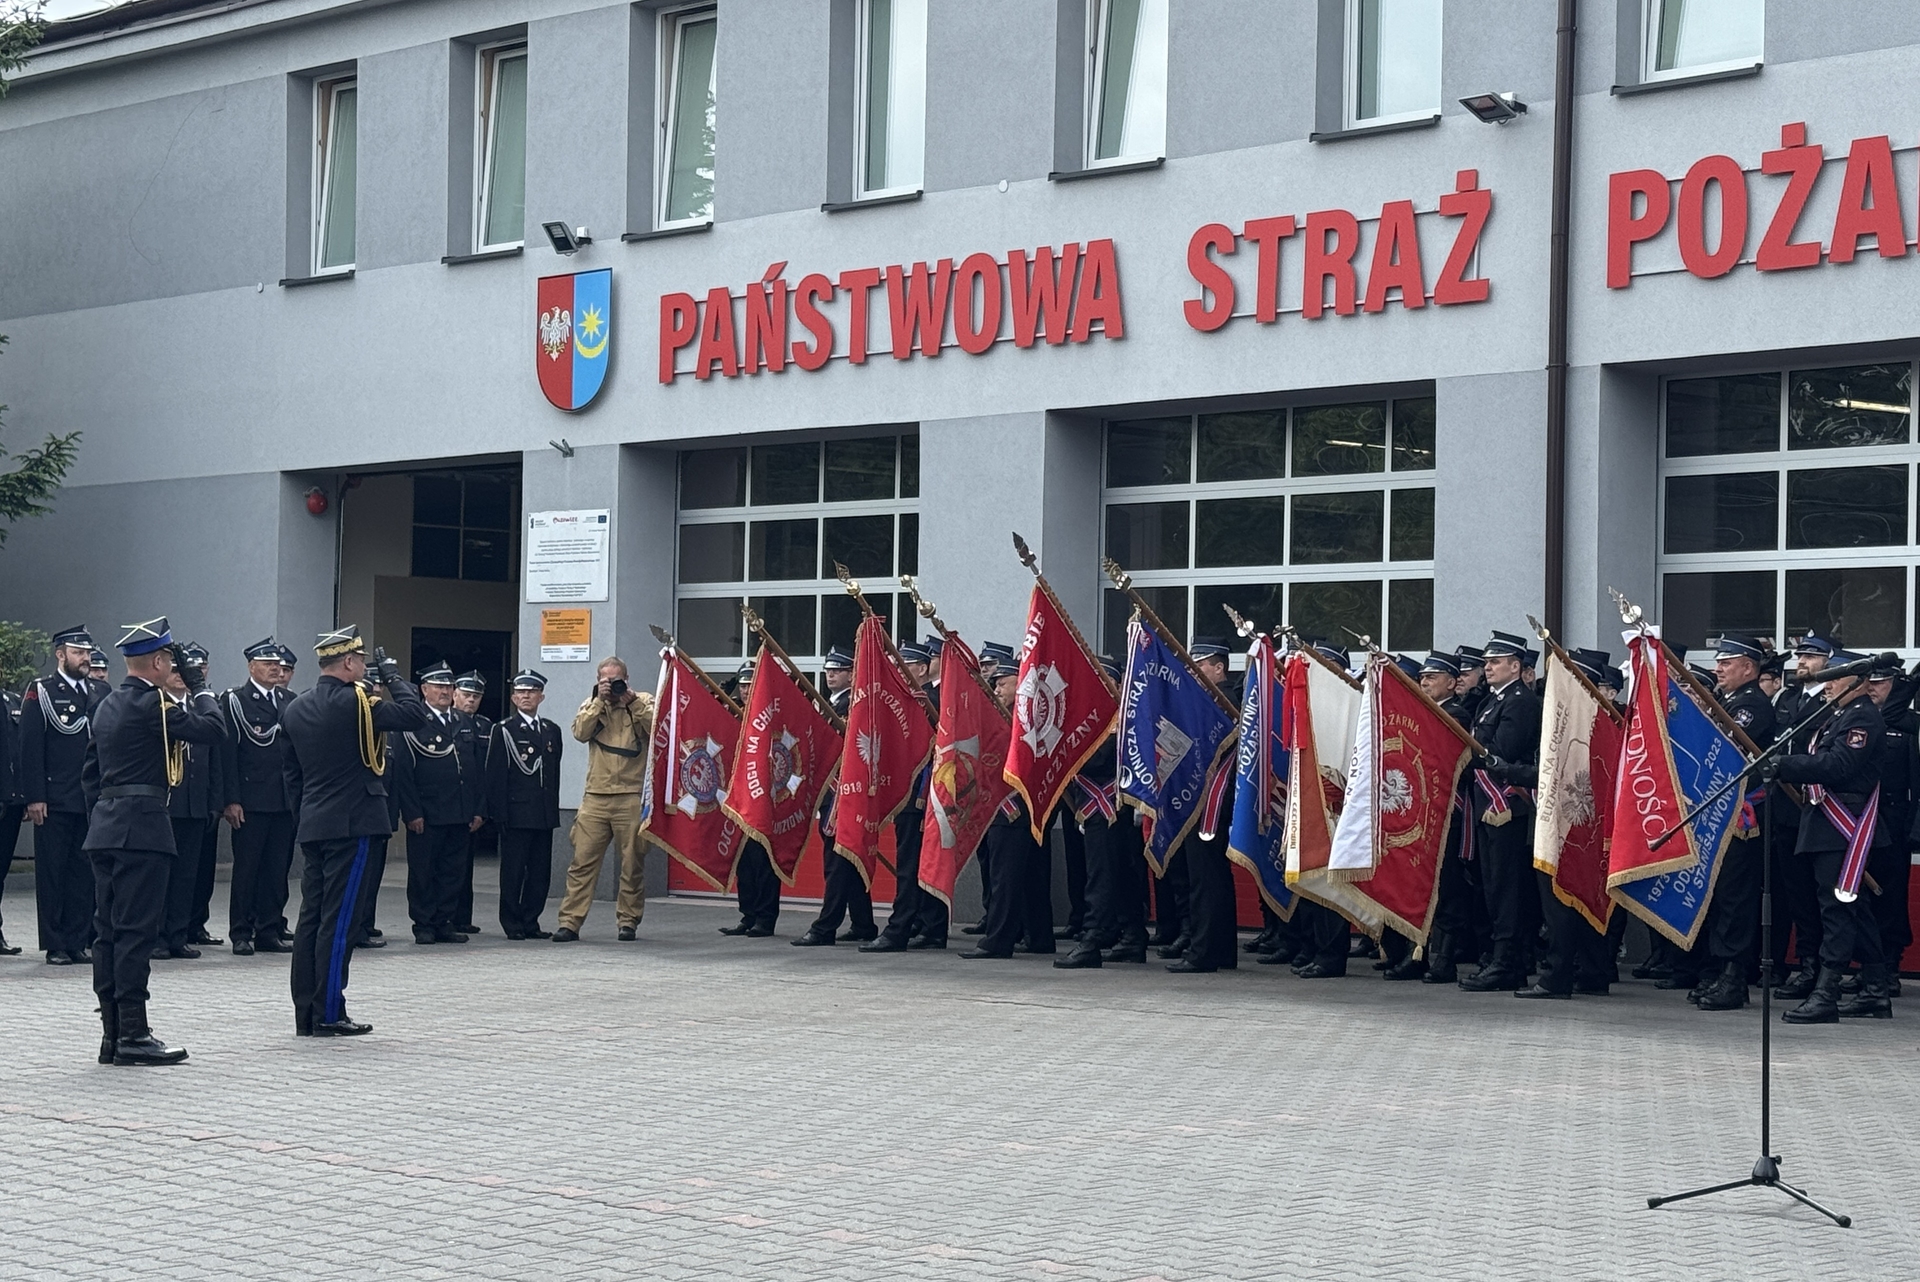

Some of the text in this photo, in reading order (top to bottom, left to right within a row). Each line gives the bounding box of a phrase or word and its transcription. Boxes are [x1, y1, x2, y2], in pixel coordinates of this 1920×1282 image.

[659, 121, 1920, 384] PAŃSTWOWA STRAŻ POŻA
[746, 735, 760, 754] NA
[1208, 720, 1224, 745] 2014
[1704, 737, 1722, 770] 2023
[746, 761, 764, 799] BOGU
[1626, 702, 1672, 851] EDNOŚC
[1682, 772, 1736, 910] W STANISŁAWOWE
[1647, 874, 1671, 903] 1973
